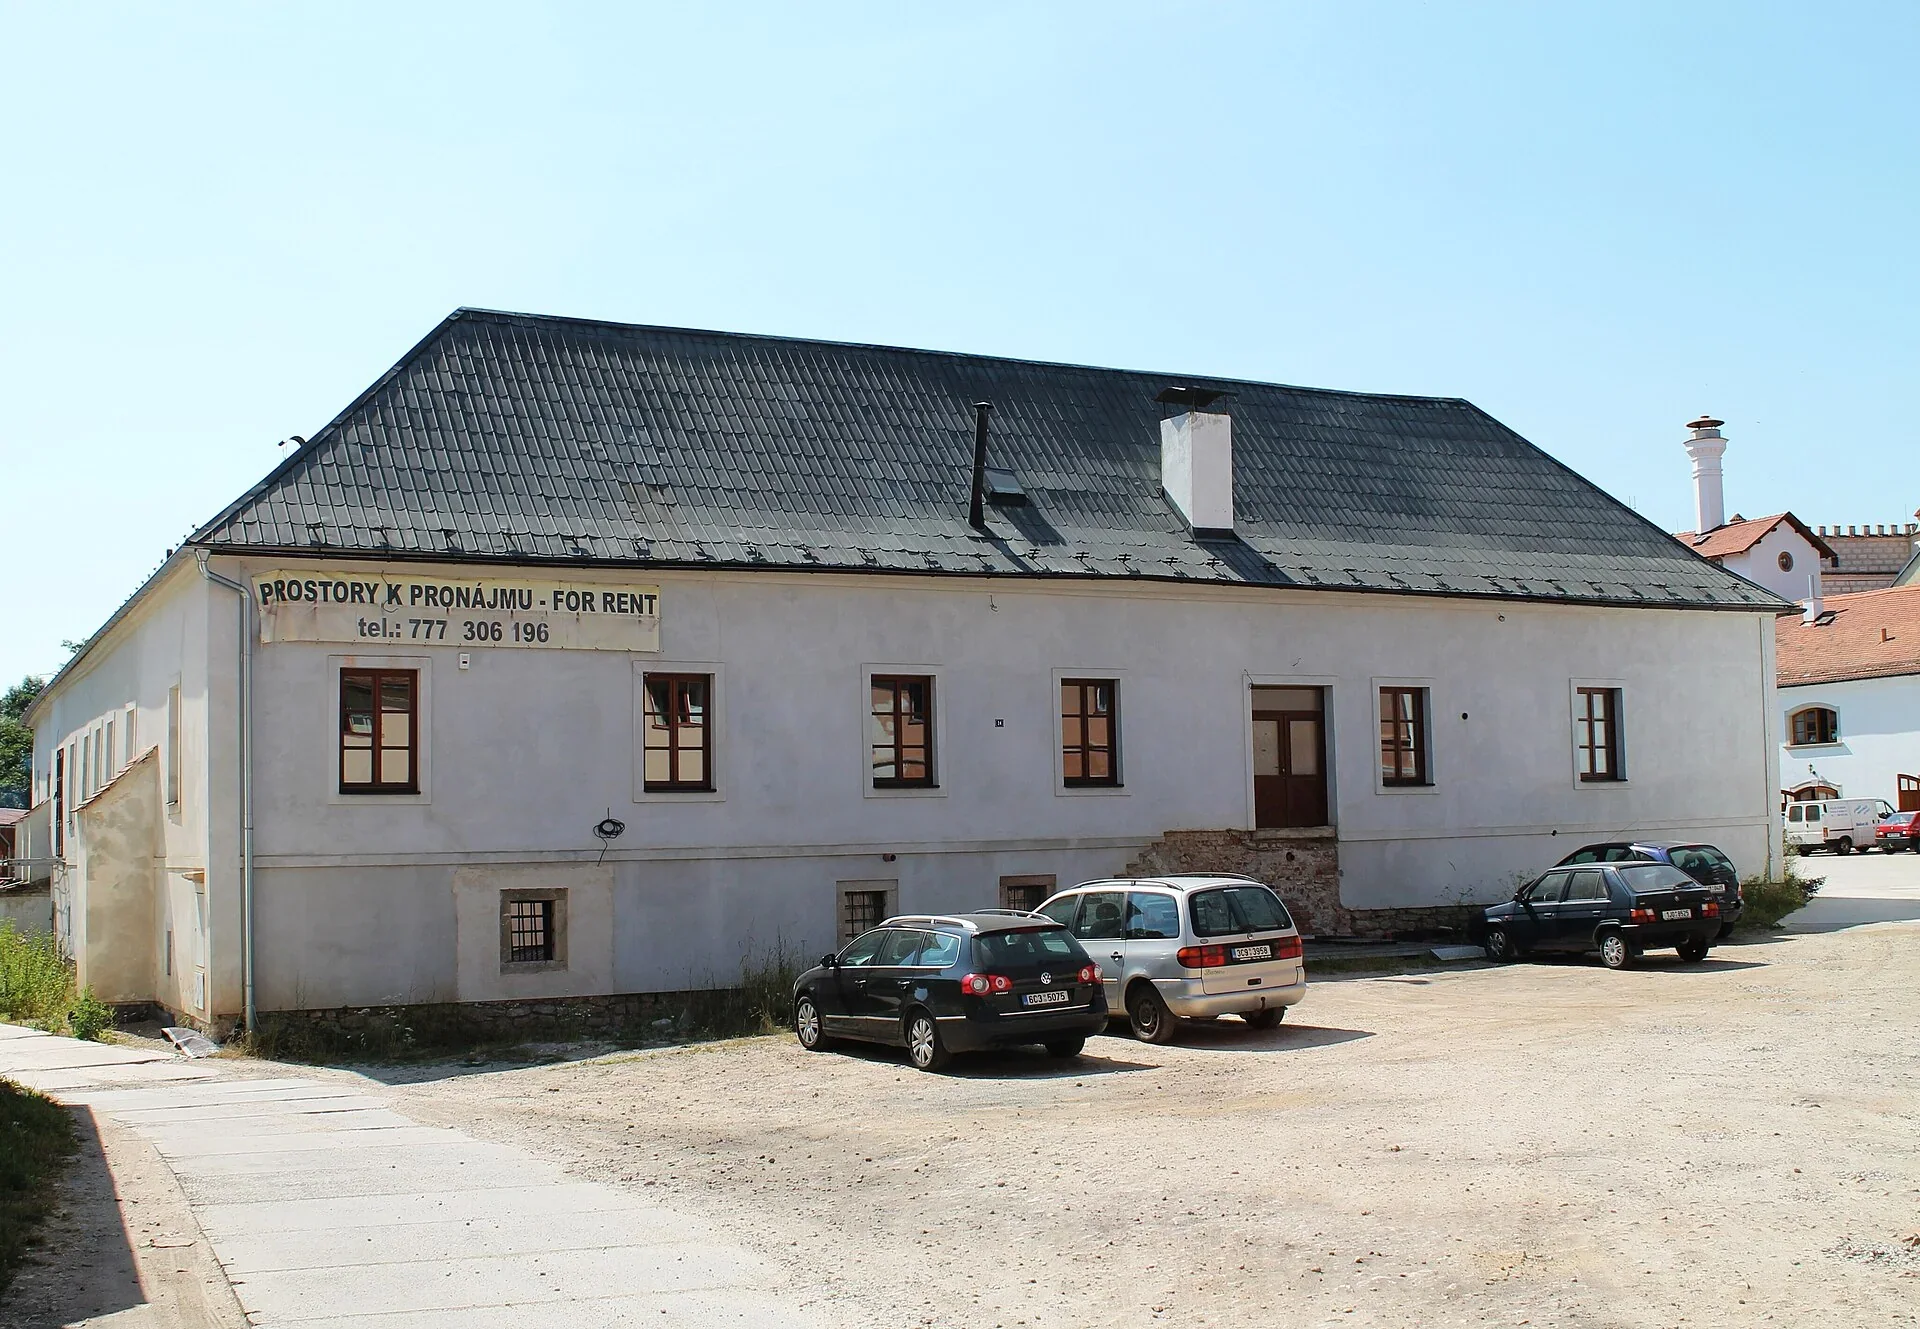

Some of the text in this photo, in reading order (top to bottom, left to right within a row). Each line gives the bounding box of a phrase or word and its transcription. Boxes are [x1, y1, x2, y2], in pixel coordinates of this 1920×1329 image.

[259, 579, 380, 606] PROSTORY
[387, 583, 403, 606] K
[410, 582, 533, 610] PRONÁJMU
[552, 589, 596, 613] FOR
[602, 592, 657, 615] RENT
[358, 617, 549, 643] tel.: 777 306 196
[1028, 991, 1066, 1004] 6C3 5075
